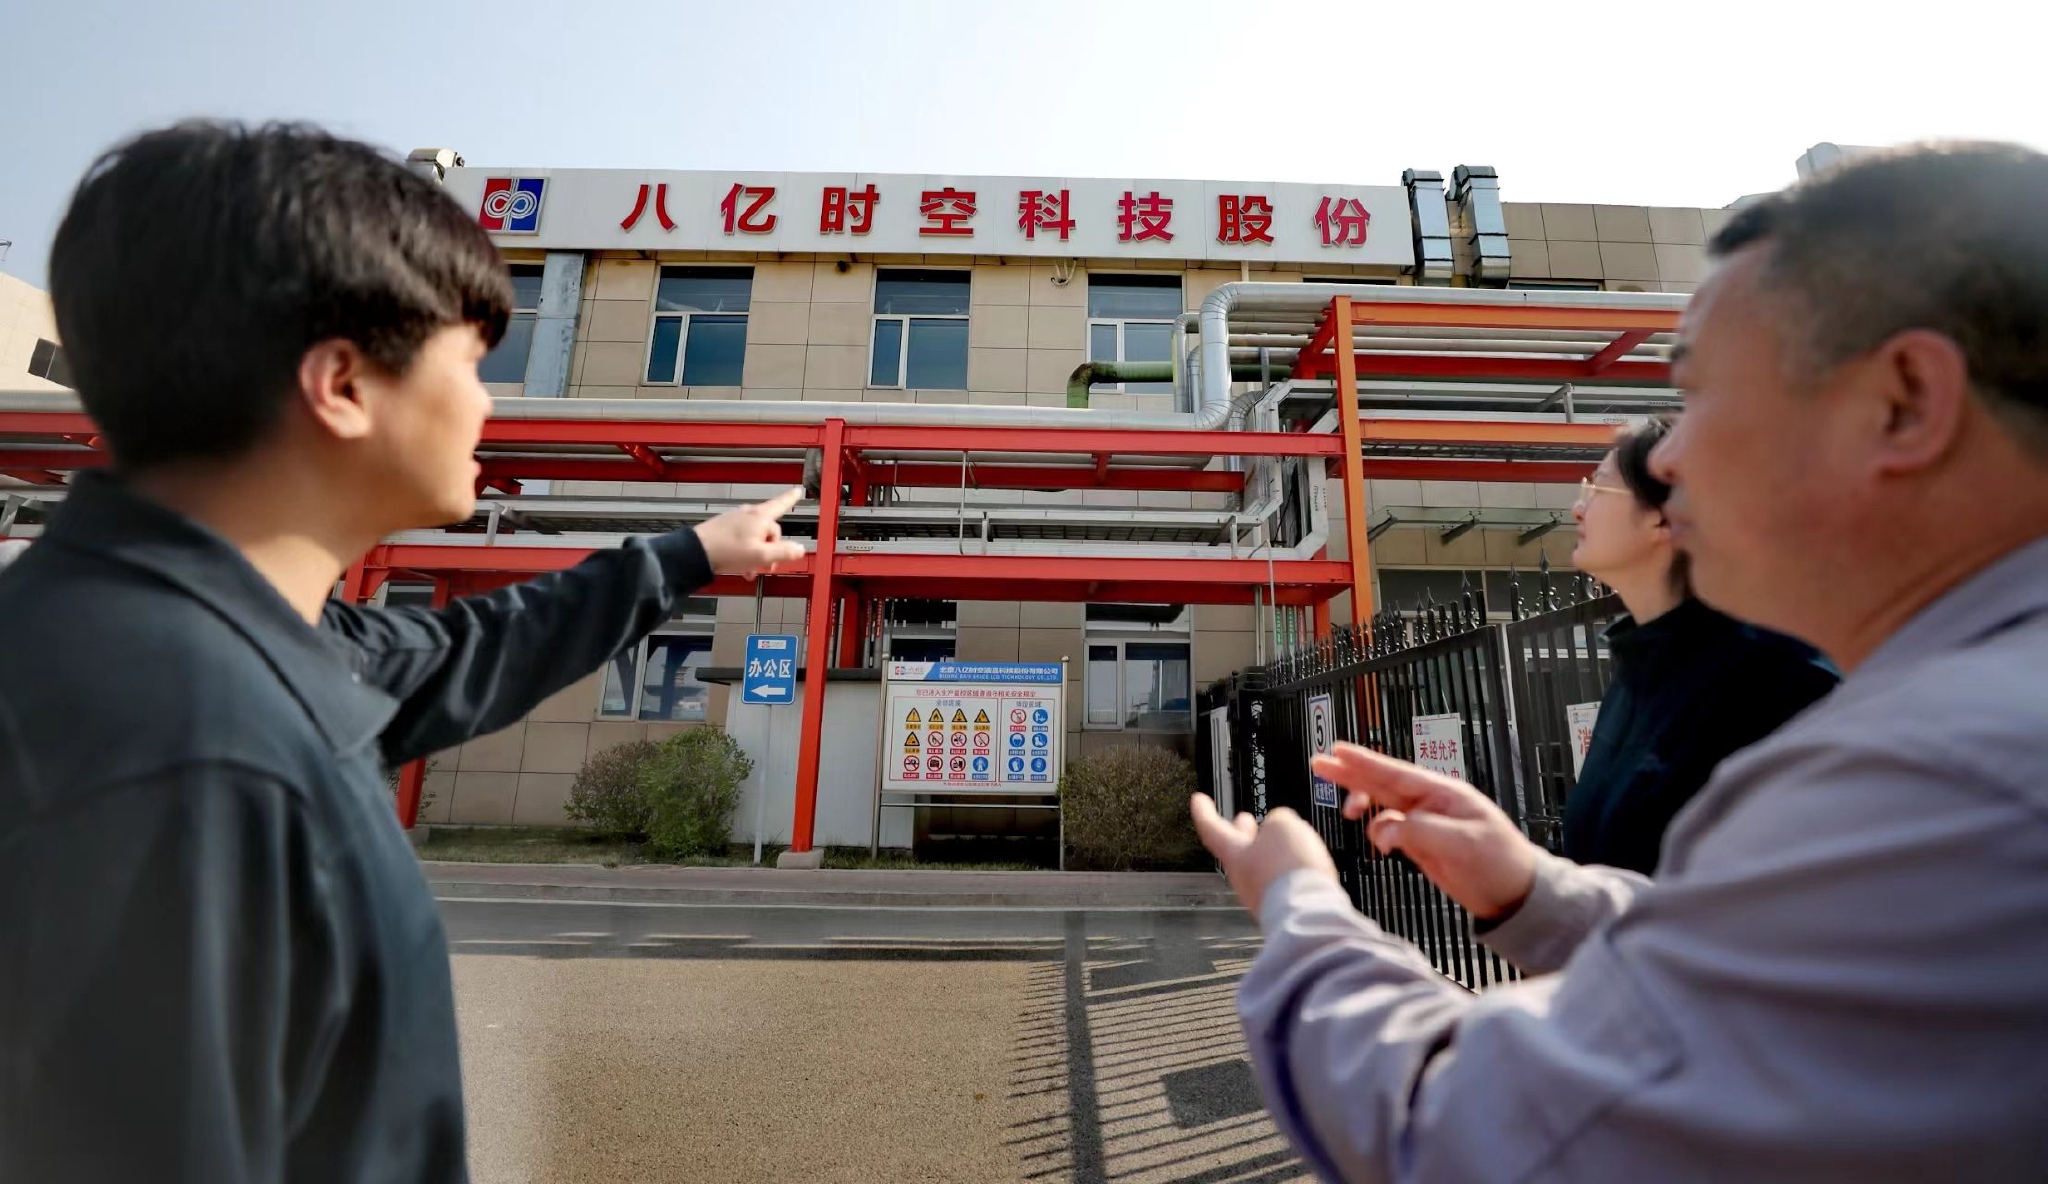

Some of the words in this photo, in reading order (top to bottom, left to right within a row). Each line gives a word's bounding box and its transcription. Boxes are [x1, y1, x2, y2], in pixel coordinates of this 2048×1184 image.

[622, 184, 1370, 246] 八亿时空科技股份
[748, 657, 792, 678] 办公区
[1315, 715, 1324, 747] 5
[1419, 739, 1458, 761] 未经允许
